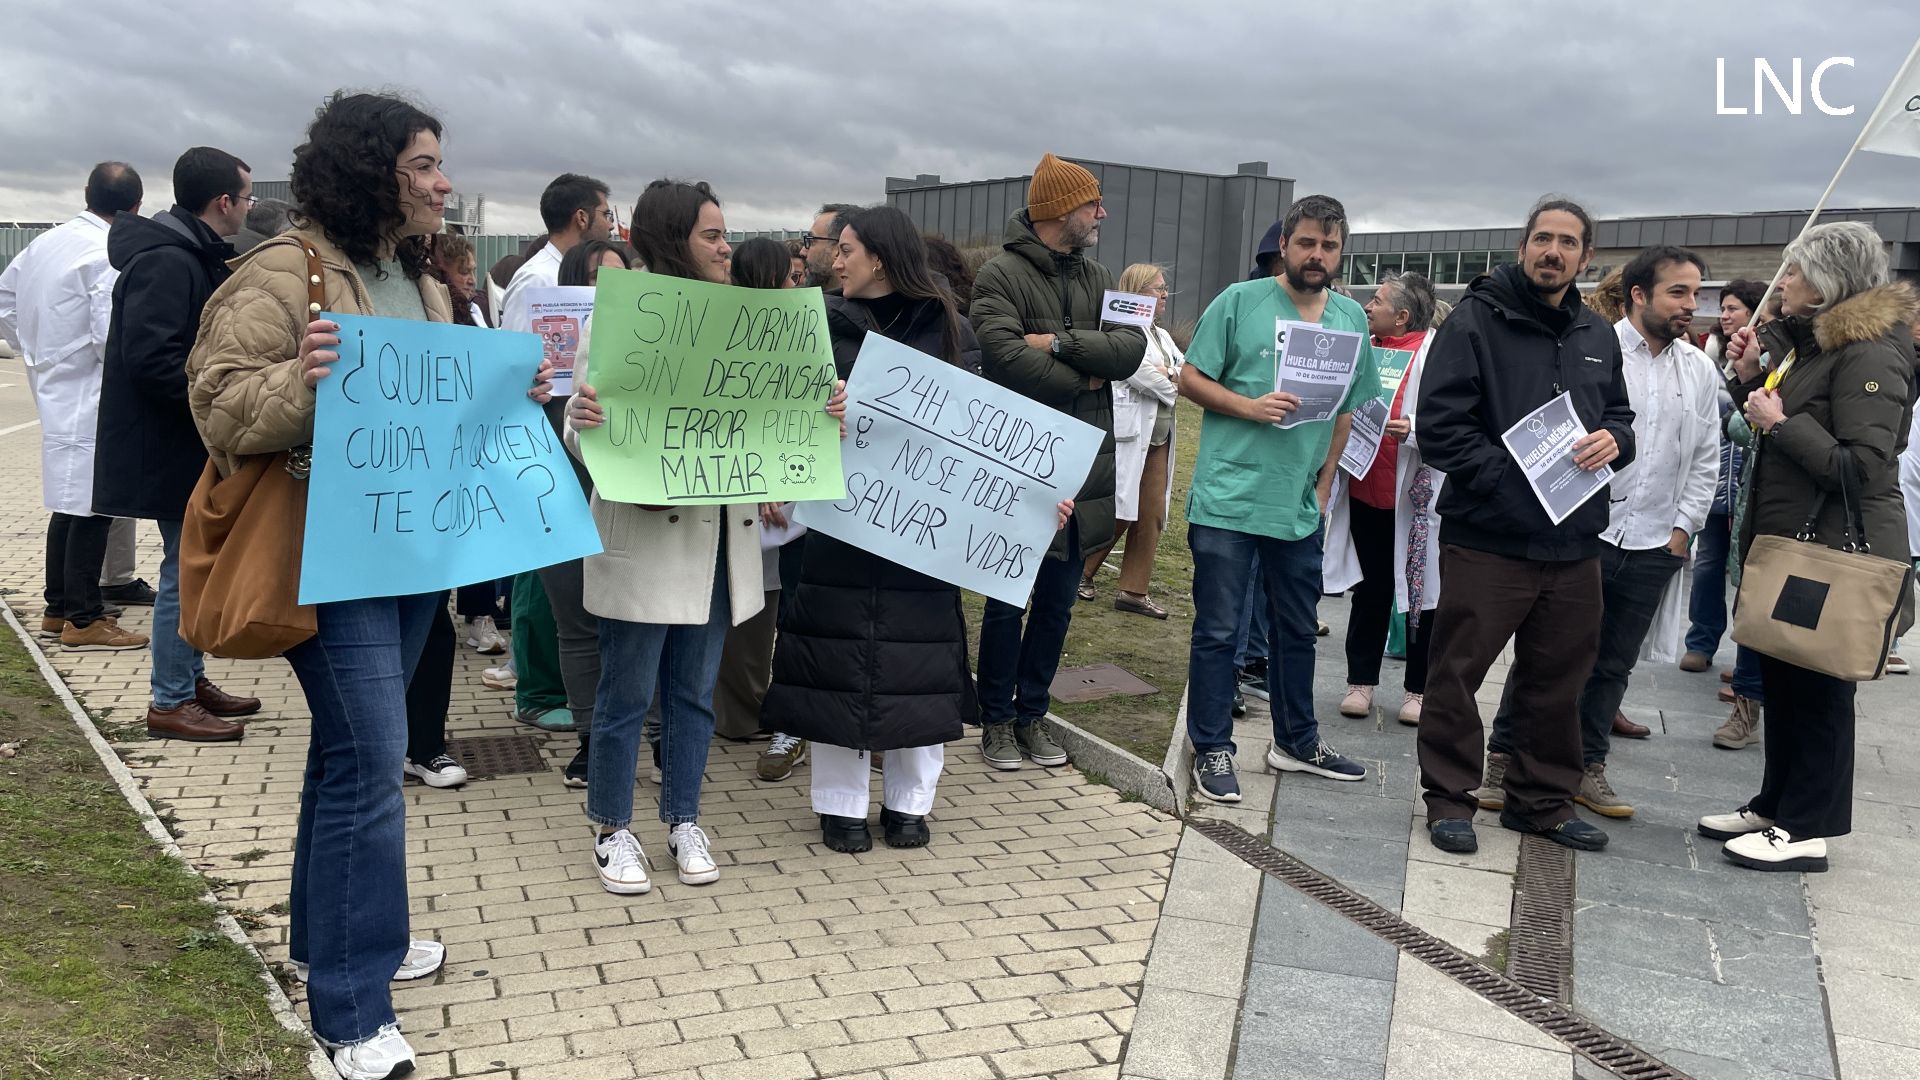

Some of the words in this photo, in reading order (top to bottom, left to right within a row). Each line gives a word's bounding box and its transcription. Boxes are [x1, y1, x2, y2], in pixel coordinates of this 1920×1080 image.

[633, 291, 710, 348] SIN
[1108, 299, 1153, 318] CESM
[619, 350, 685, 397] SIN
[702, 358, 837, 402] DESCANSAR
[1286, 354, 1318, 370] HUELGA
[1319, 358, 1350, 373] MÉDICA
[1310, 373, 1338, 381] DICIEMBRE
[346, 421, 430, 474] CUIDA
[609, 407, 651, 447] UN
[663, 406, 748, 450] ERROR
[762, 409, 824, 447] PUEDE
[873, 365, 950, 427] 24H
[950, 398, 1065, 480] SEGUIDAS
[1522, 440, 1552, 468] HUELGA
[1546, 418, 1575, 447] MÉDICA
[660, 452, 769, 494] MATAR
[891, 438, 933, 482] NO
[927, 456, 963, 494] SE
[961, 467, 1027, 517] PUEDE
[365, 490, 415, 534] TE
[833, 472, 947, 550] SALVAR
[966, 524, 1033, 579] VIDAS
